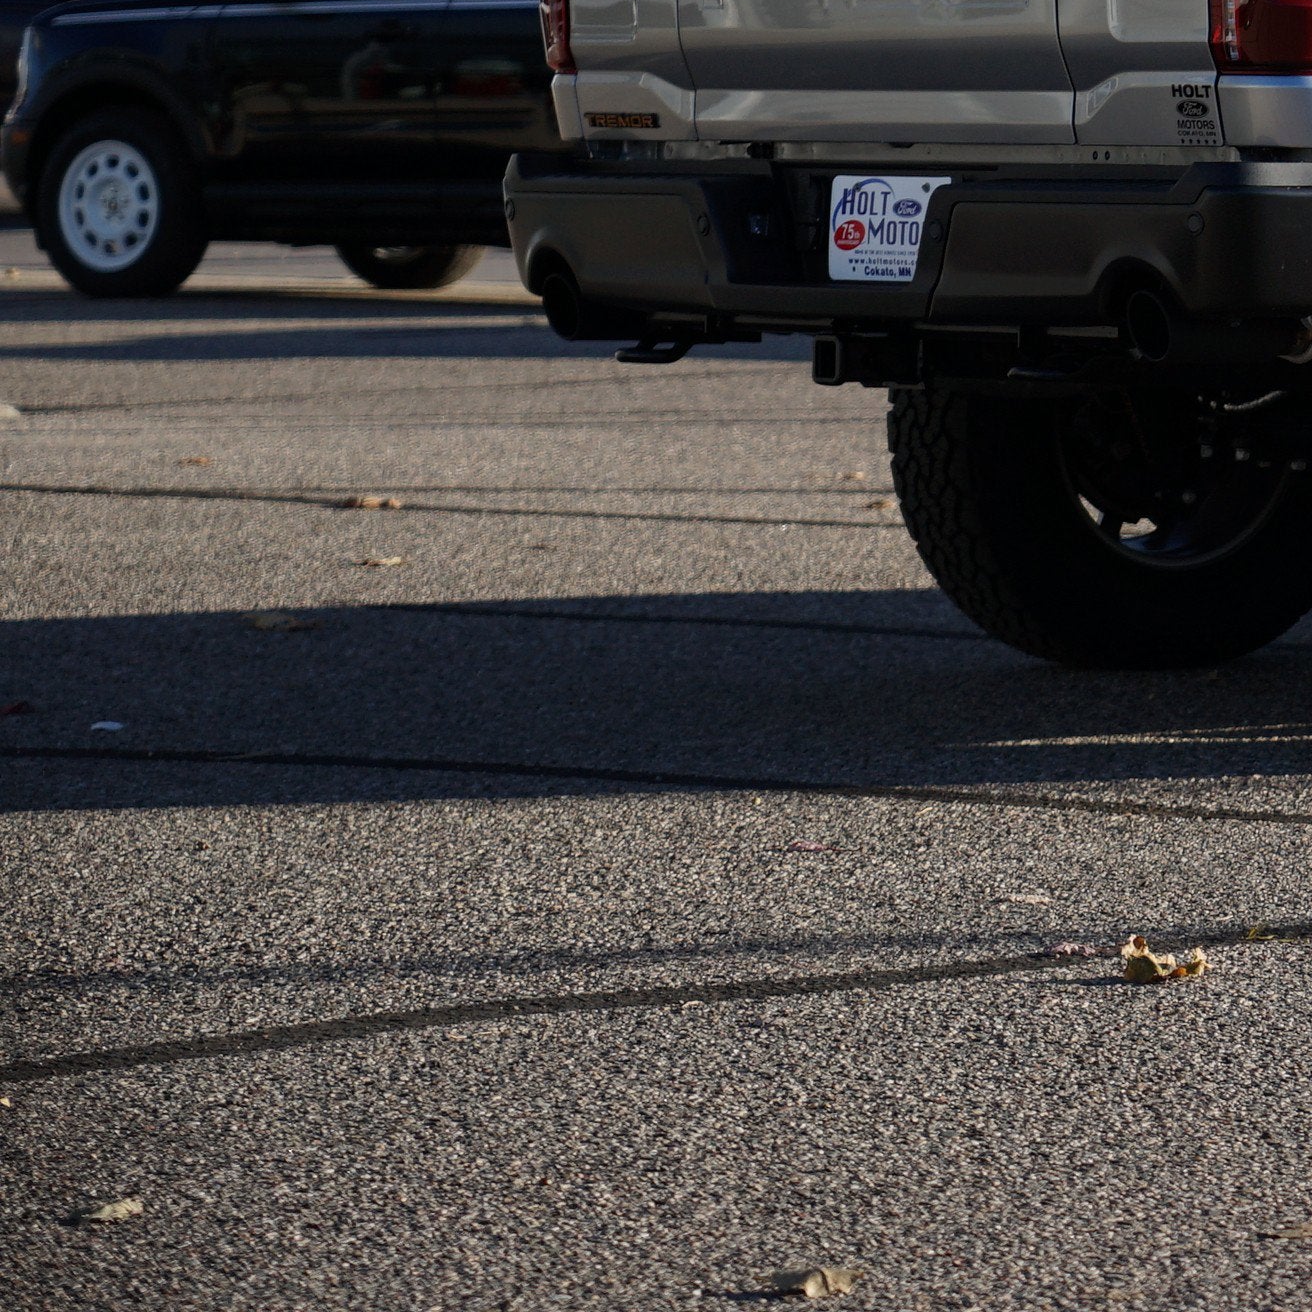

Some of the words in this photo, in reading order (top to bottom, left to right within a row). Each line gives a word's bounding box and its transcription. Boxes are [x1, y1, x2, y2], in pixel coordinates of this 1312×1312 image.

[1171, 84, 1211, 98] HOLT
[584, 112, 661, 128] TREMOR
[1177, 119, 1215, 130] MOTORS
[841, 188, 891, 216] HOLT
[864, 266, 897, 278] Cokato,
[898, 267, 912, 277] MN
